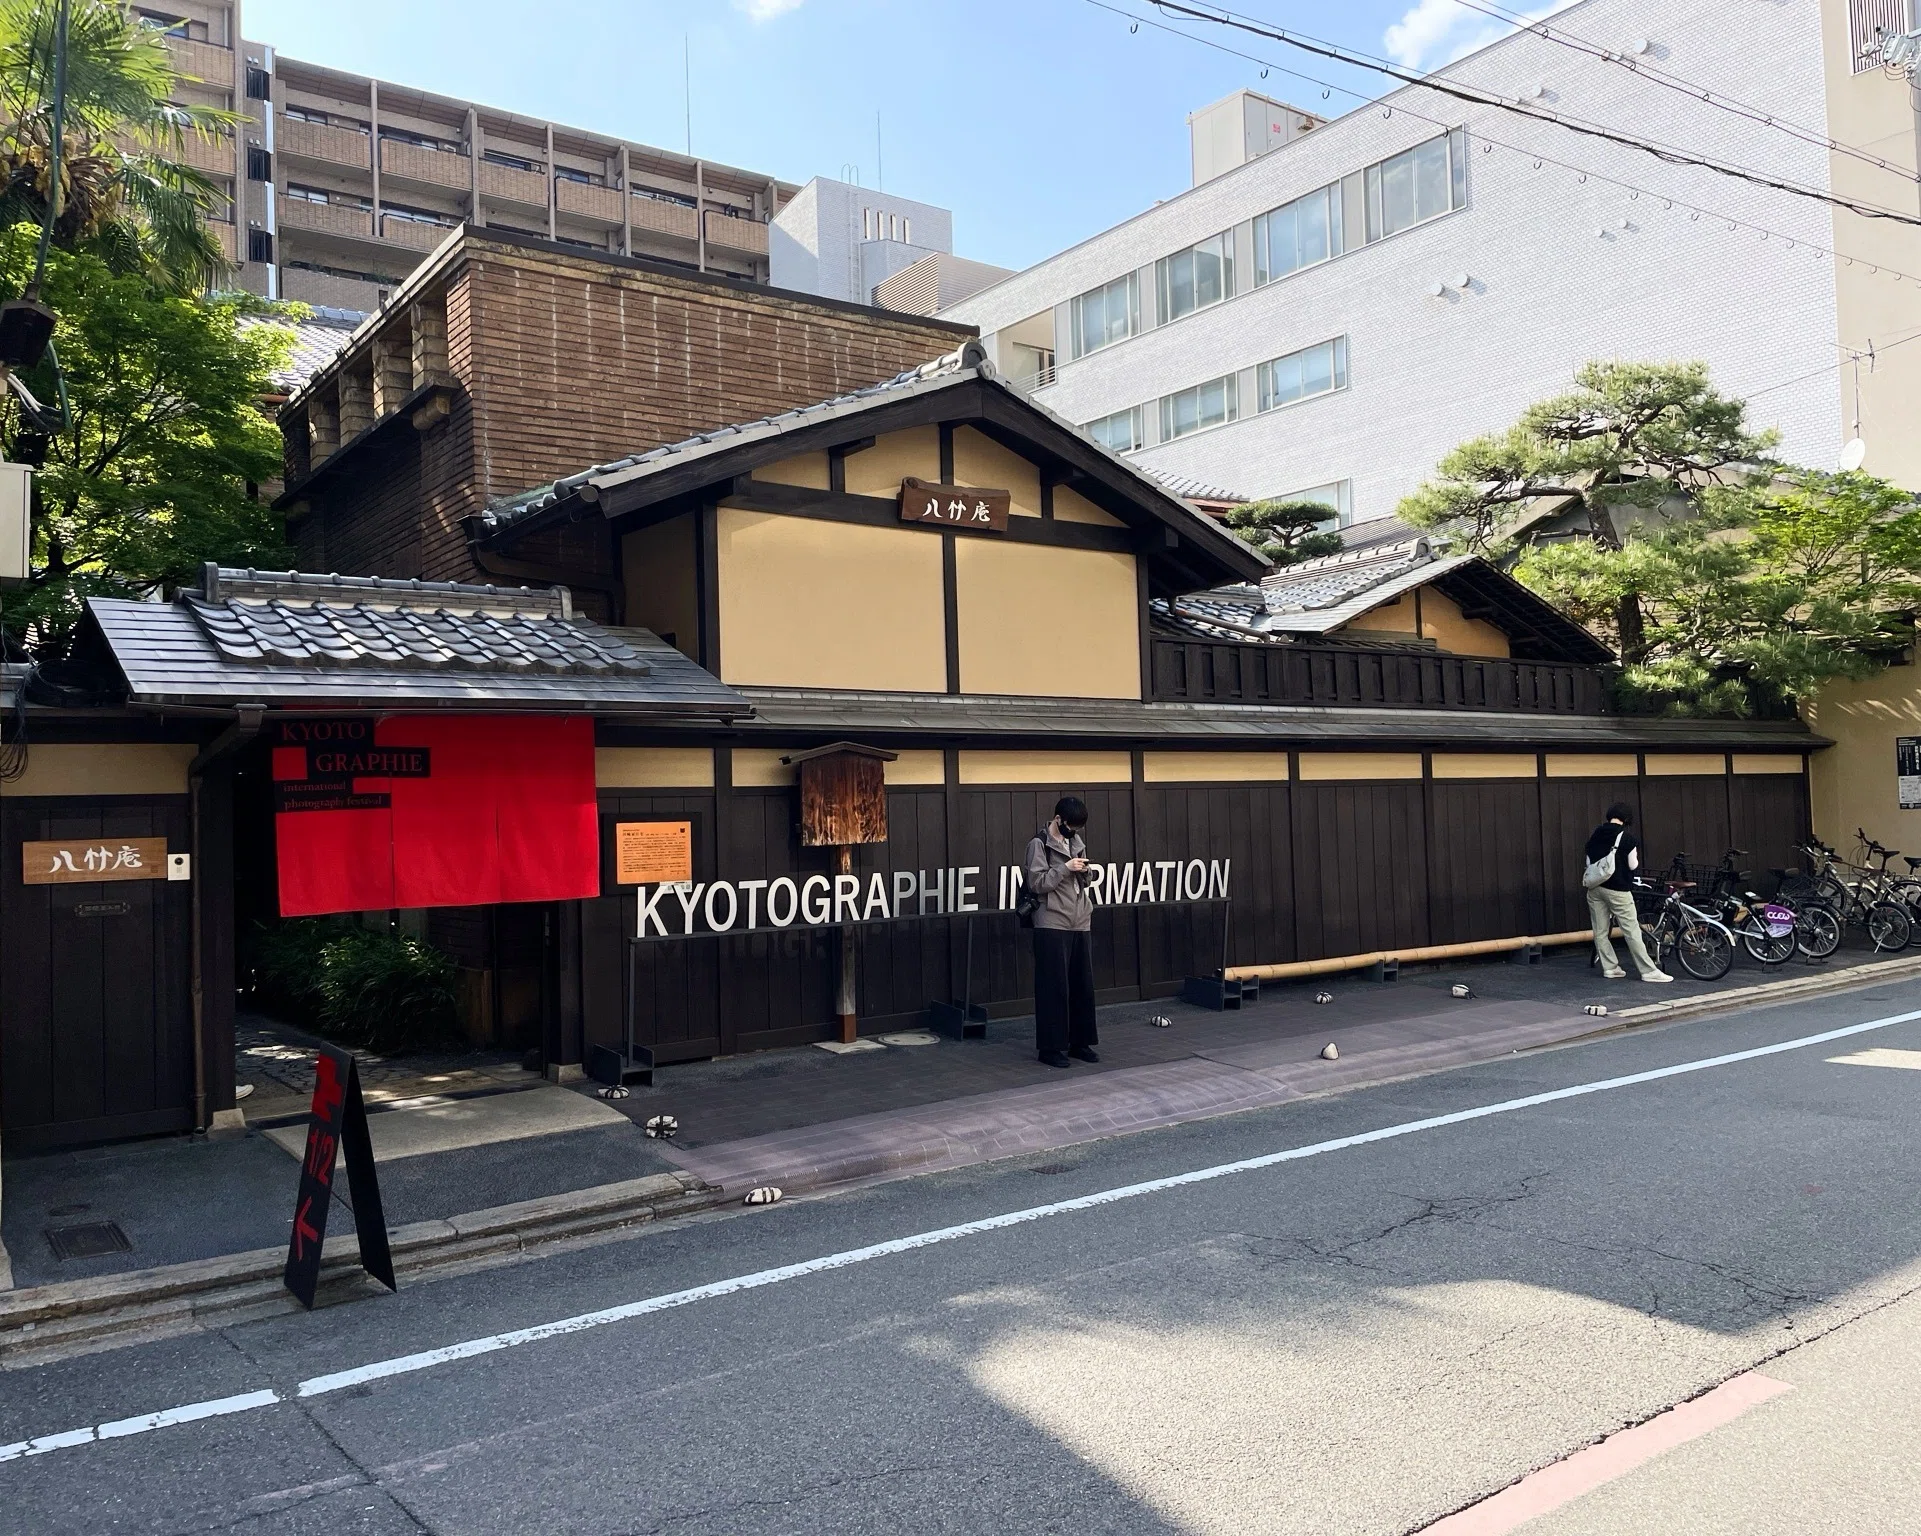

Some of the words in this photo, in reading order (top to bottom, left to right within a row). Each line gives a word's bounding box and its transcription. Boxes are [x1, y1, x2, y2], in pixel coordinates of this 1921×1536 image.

[922, 498, 991, 522] 八竹庵
[281, 721, 366, 741] KYOTO
[315, 753, 423, 772] GRAPHIE
[283, 780, 346, 792] international
[284, 797, 345, 811] photography
[347, 795, 382, 806] festival
[48, 845, 143, 874] 八竹庵
[636, 866, 980, 938] KYOTOGRAPHIE
[998, 858, 1231, 911] INRMATION
